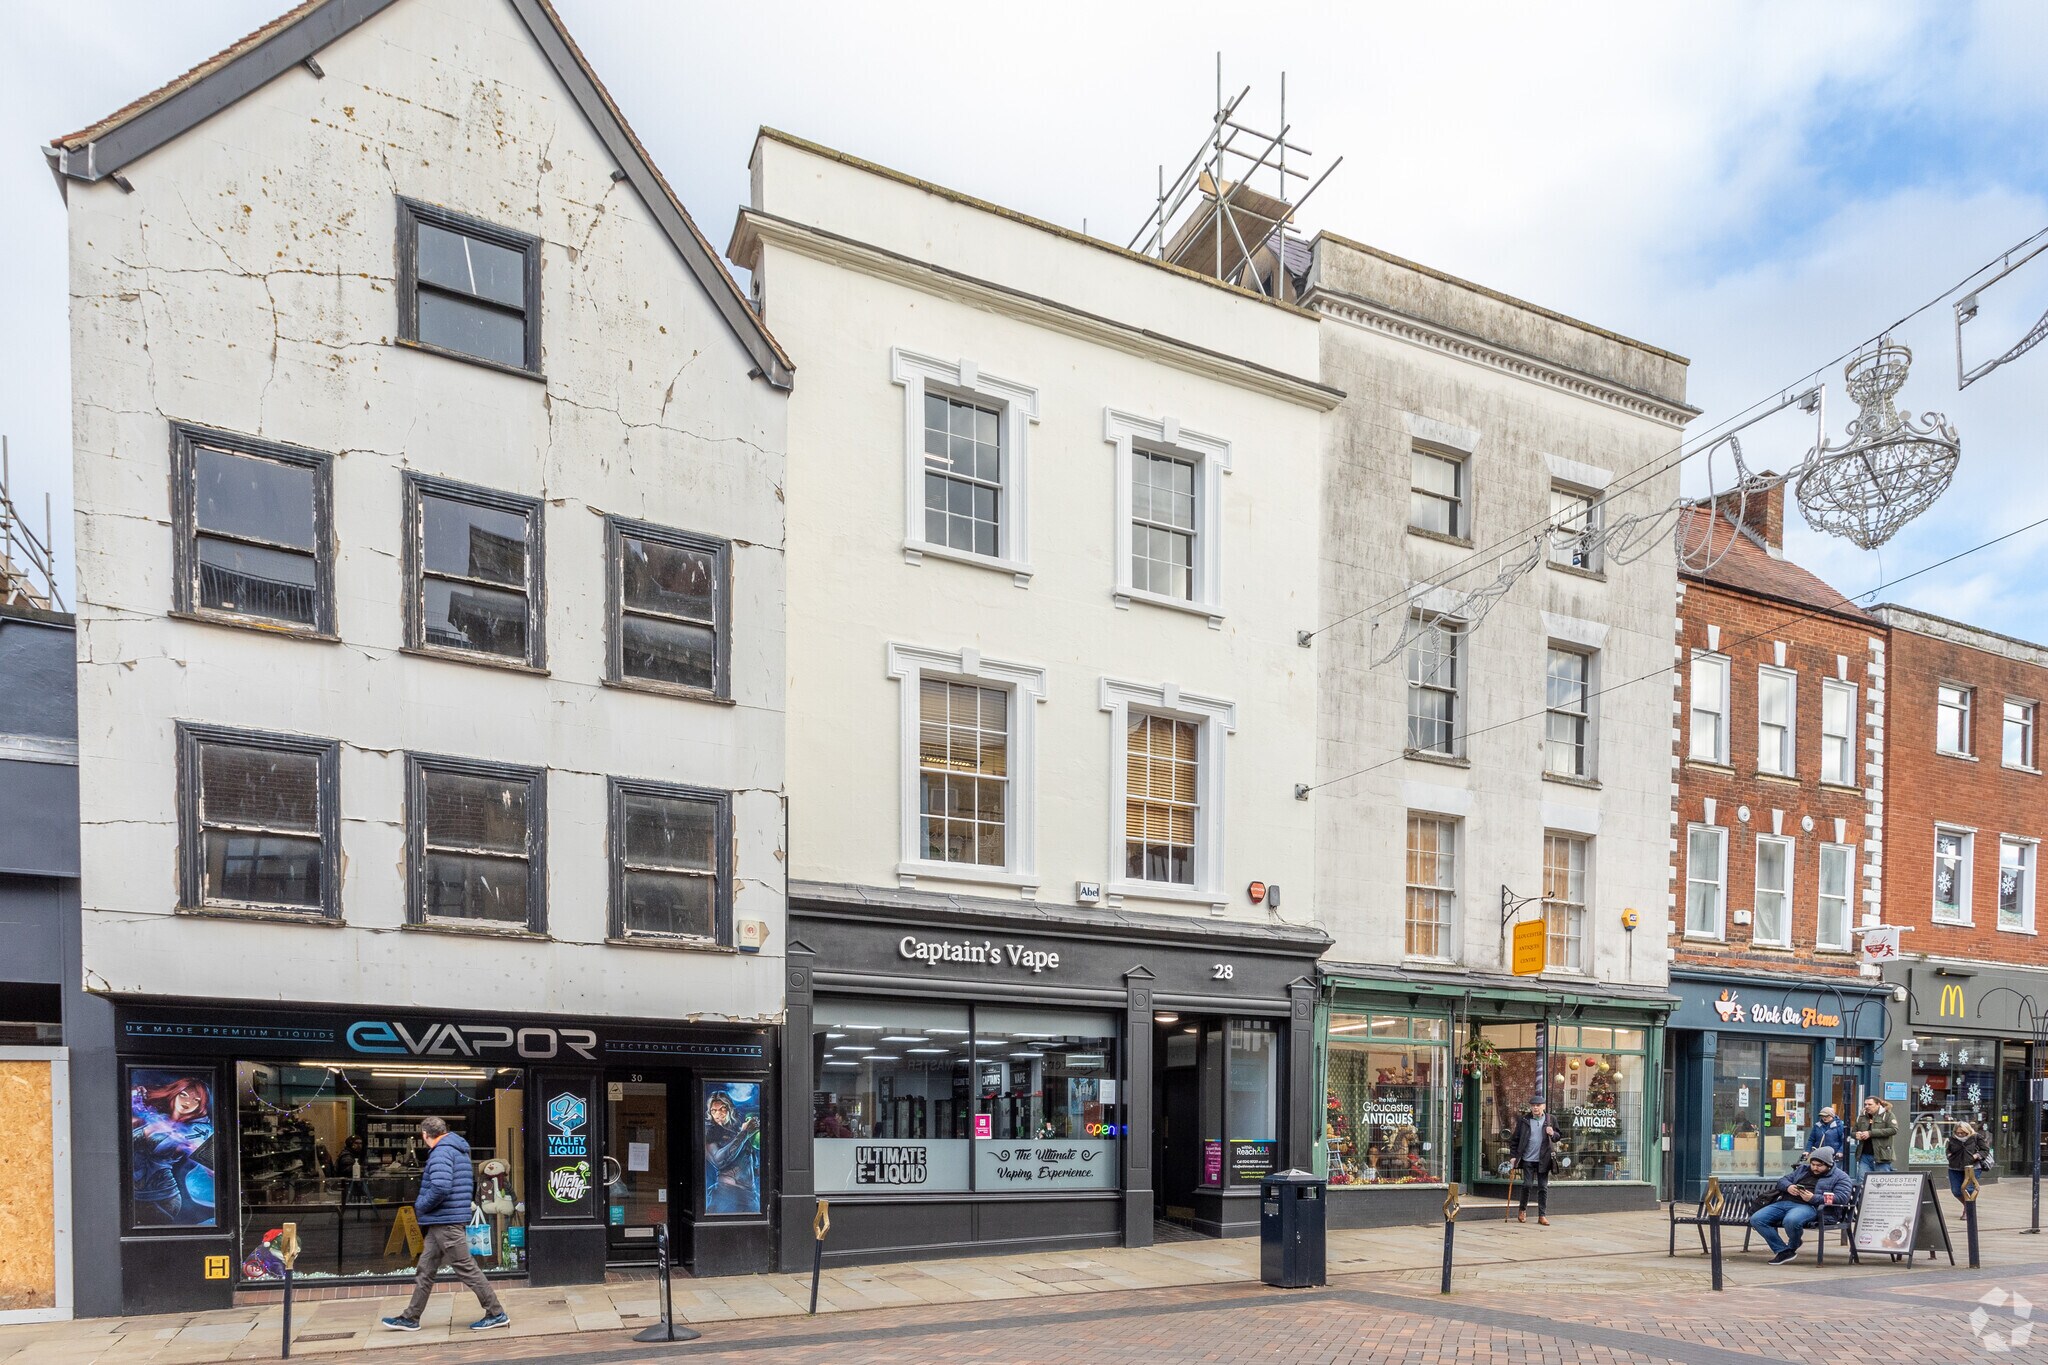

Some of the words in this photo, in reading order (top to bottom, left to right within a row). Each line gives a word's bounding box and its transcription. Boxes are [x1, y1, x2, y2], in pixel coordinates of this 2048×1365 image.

[1081, 887, 1099, 897] Abel
[900, 936, 1001, 965] Captain's
[1006, 944, 1059, 972] Vape
[1213, 964, 1233, 979] 28
[1751, 1003, 1781, 1024] Wok
[1781, 1006, 1801, 1025] On
[153, 1026, 193, 1034] MADE
[203, 1028, 268, 1036] PREMIUM
[605, 1043, 682, 1051] ELECTRONIC
[690, 1045, 762, 1054] CIGARETTES
[631, 1074, 643, 1082] 30
[1362, 1101, 1413, 1112] Gloucester
[1573, 1105, 1616, 1116] Gloucester
[1361, 1112, 1413, 1125] ANTIQUES
[1572, 1116, 1616, 1127] ANTIQUES
[1086, 1123, 1116, 1136] open
[548, 1136, 586, 1146] VALLEY
[549, 1146, 586, 1155] LIQUID
[856, 1146, 926, 1164] ULTIMATE
[1014, 1149, 1032, 1160] The
[1035, 1148, 1077, 1163] Ultimate
[1236, 1147, 1256, 1156] Reach
[856, 1163, 927, 1185] E-LIQUID
[997, 1167, 1032, 1181] Vaping
[1037, 1166, 1094, 1180] Experience.
[209, 1259, 226, 1276] H
